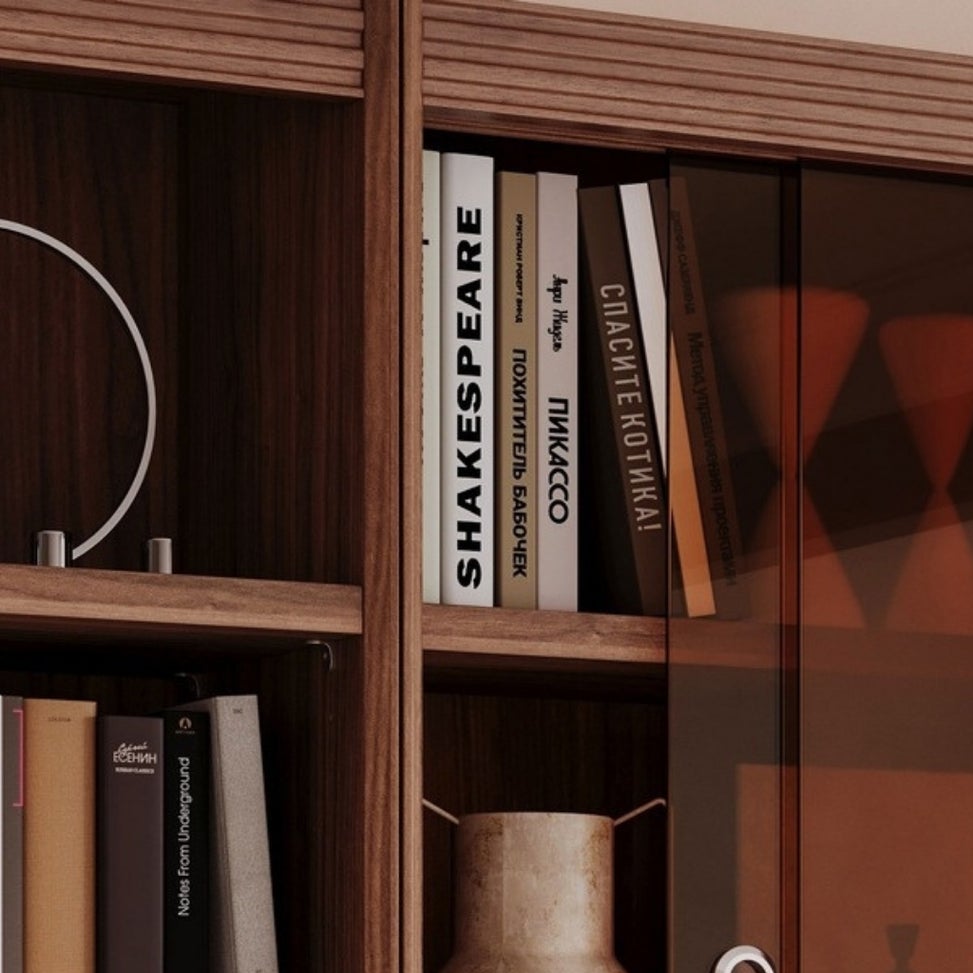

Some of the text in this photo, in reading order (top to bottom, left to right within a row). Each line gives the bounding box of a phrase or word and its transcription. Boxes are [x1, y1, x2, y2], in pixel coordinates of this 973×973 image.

[456, 206, 483, 590] SHAKESPEARE
[511, 349, 528, 578] ПОХИТИТЕЛЬ БАБОЧЕК
[547, 397, 569, 525] ПИКАССО
[599, 283, 662, 532] СПАСИТЕ КОТИКА!
[113, 751, 157, 764] ЕСЕНИН
[178, 756, 193, 917] Notes From Underground
